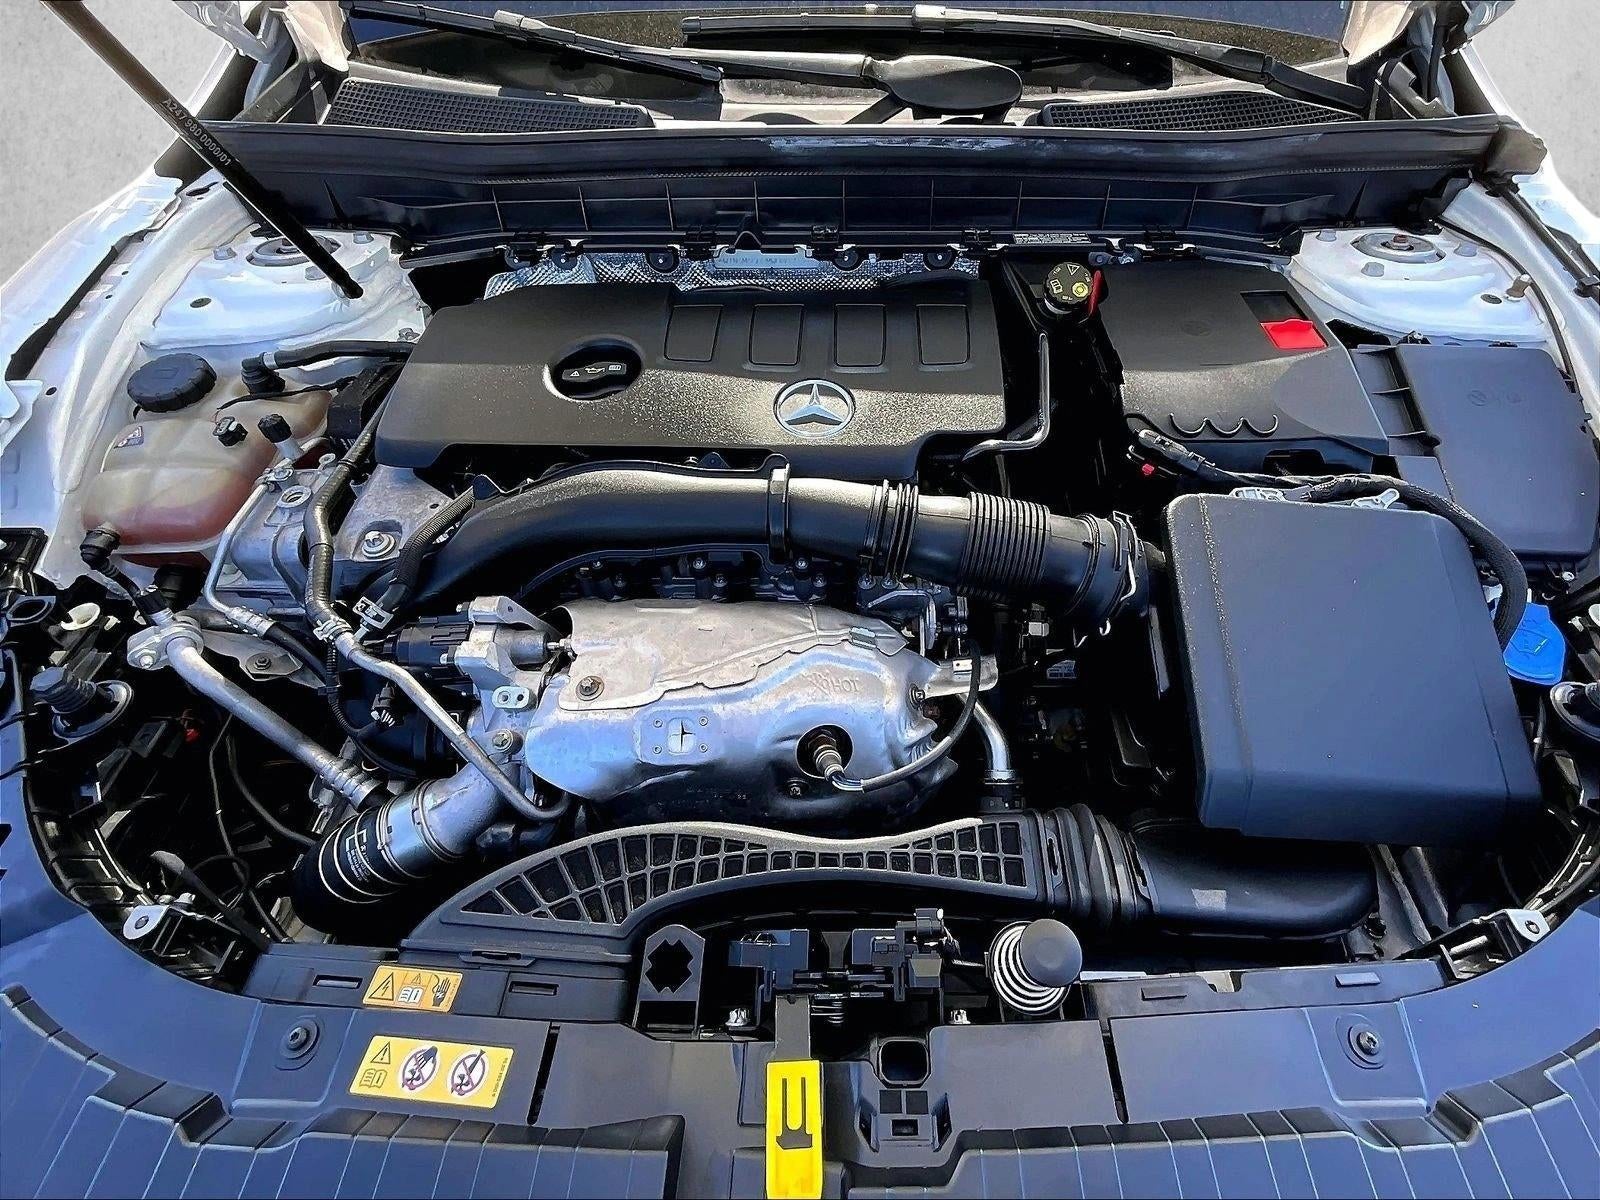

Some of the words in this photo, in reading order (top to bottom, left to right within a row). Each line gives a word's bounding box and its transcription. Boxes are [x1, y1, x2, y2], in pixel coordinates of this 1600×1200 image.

[162, 98, 187, 120] A247
[184, 119, 202, 137] 980
[200, 134, 231, 166] 0000/01
